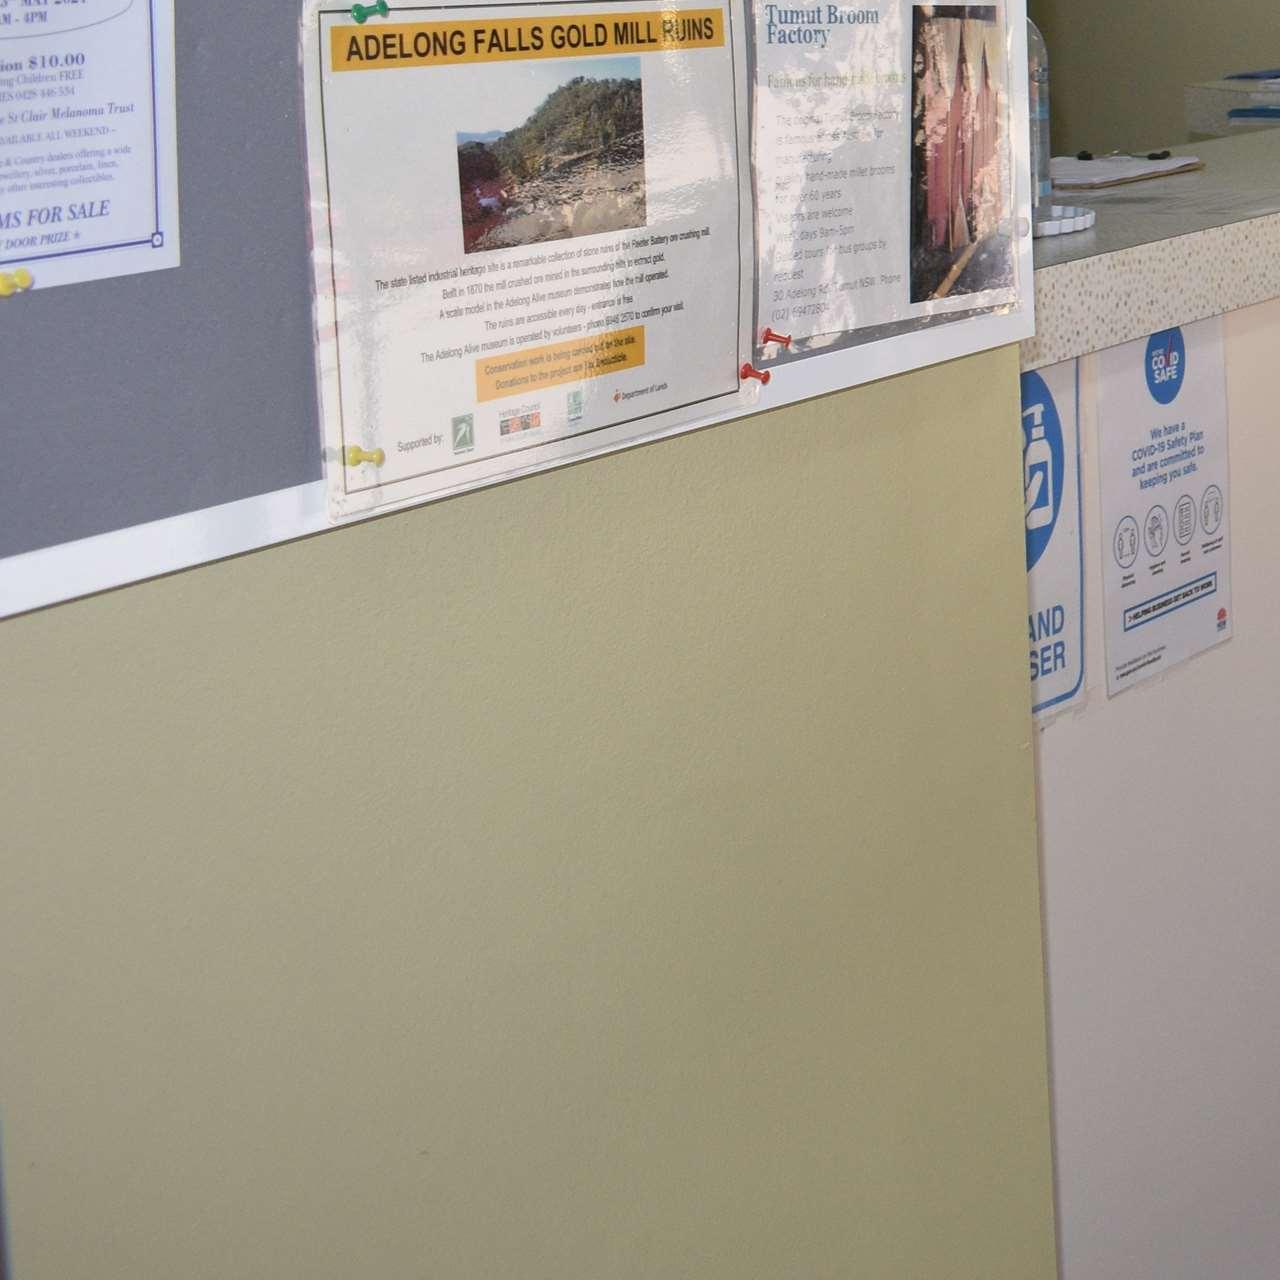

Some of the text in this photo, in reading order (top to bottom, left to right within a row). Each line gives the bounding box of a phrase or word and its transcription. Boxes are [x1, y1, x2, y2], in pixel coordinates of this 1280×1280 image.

[766, 4, 880, 24] Tumut Broom
[346, 31, 467, 62] ADELONG
[473, 25, 544, 53] FALLS
[551, 23, 608, 50] GOLD
[614, 21, 657, 44] MILL
[767, 24, 830, 48] Factory
[51, 102, 136, 120] Melanoma Trust
[27, 199, 111, 226] FOR SALE
[1154, 367, 1178, 384] SAFE
[1139, 472, 1168, 490] keeping
[1169, 467, 1181, 482] you
